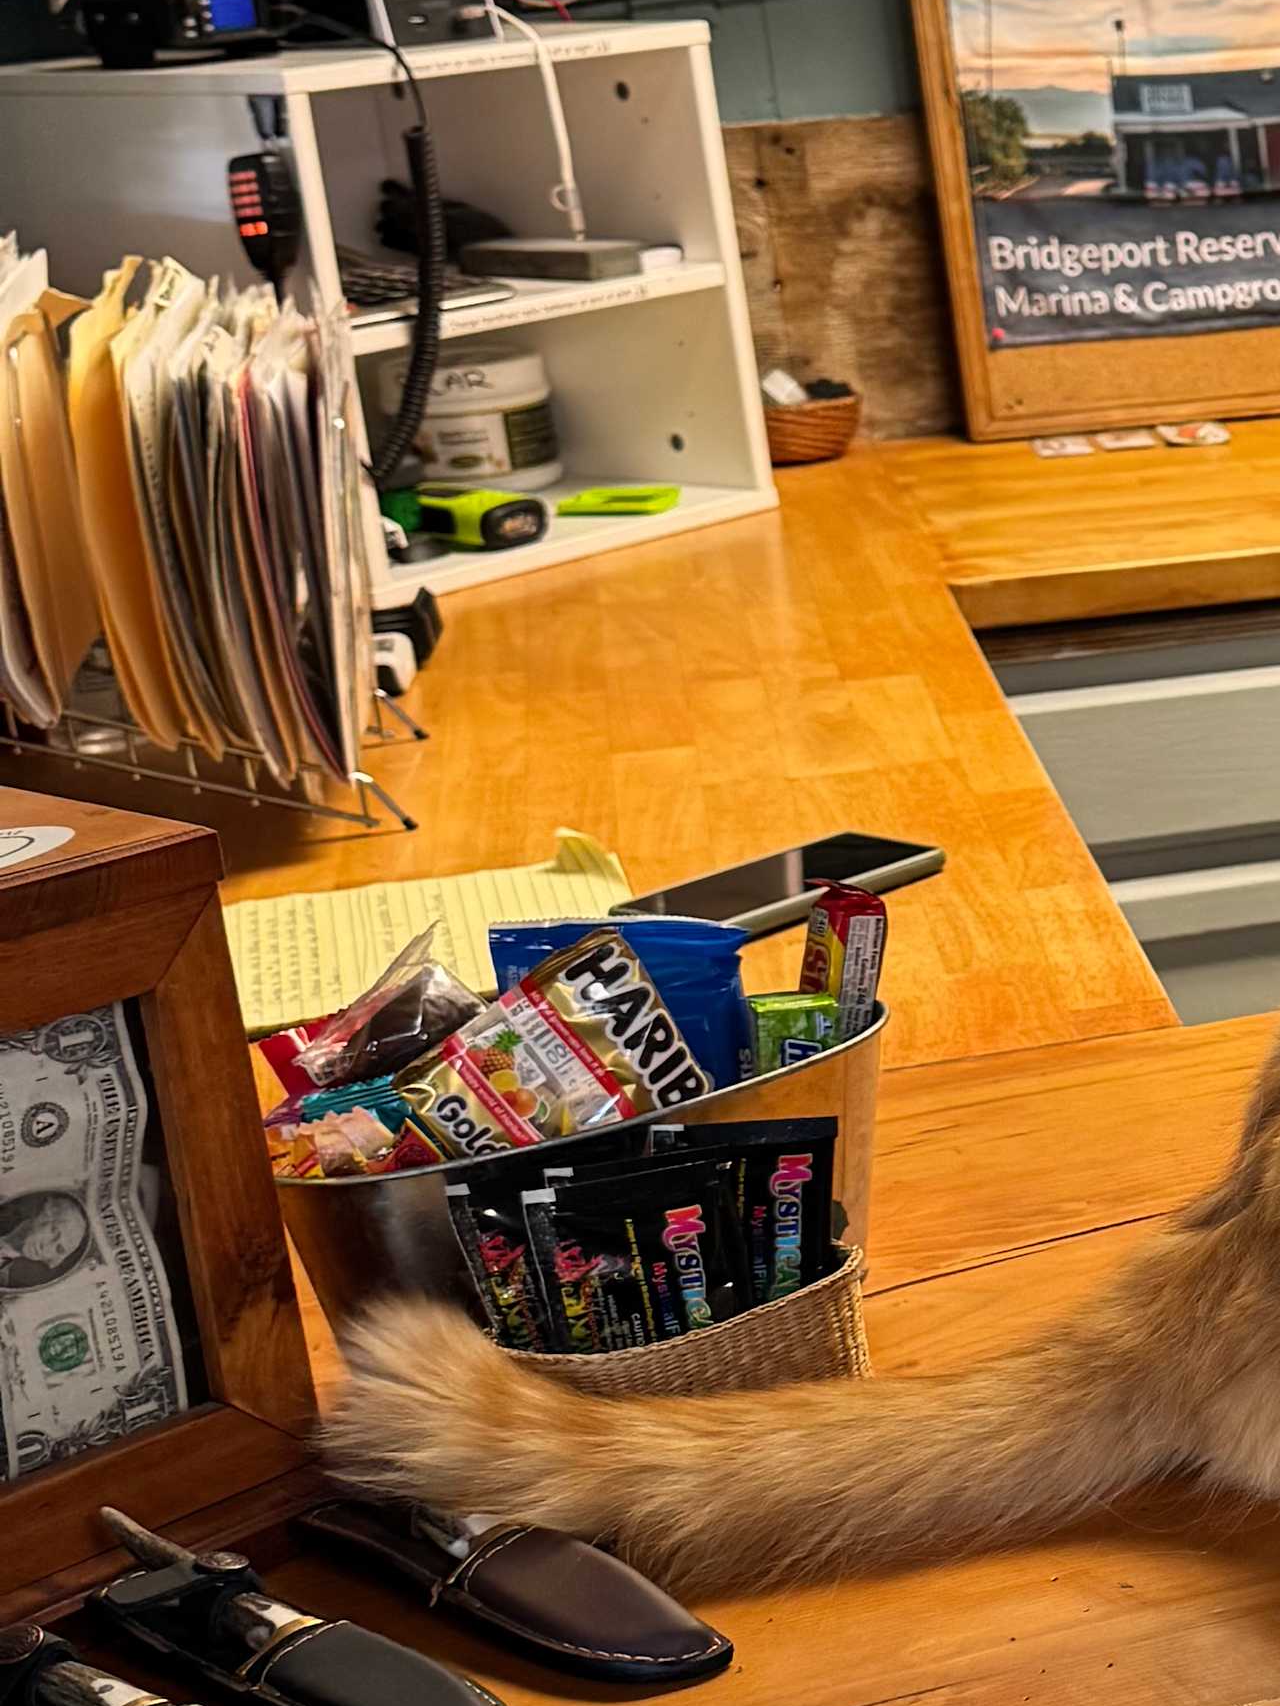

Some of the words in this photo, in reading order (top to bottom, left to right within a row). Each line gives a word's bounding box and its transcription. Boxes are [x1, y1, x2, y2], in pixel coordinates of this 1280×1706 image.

[988, 234, 1172, 274] Bridgeport
[994, 283, 1109, 317] Marina
[1113, 283, 1140, 314] &
[562, 944, 705, 1106] HARIB
